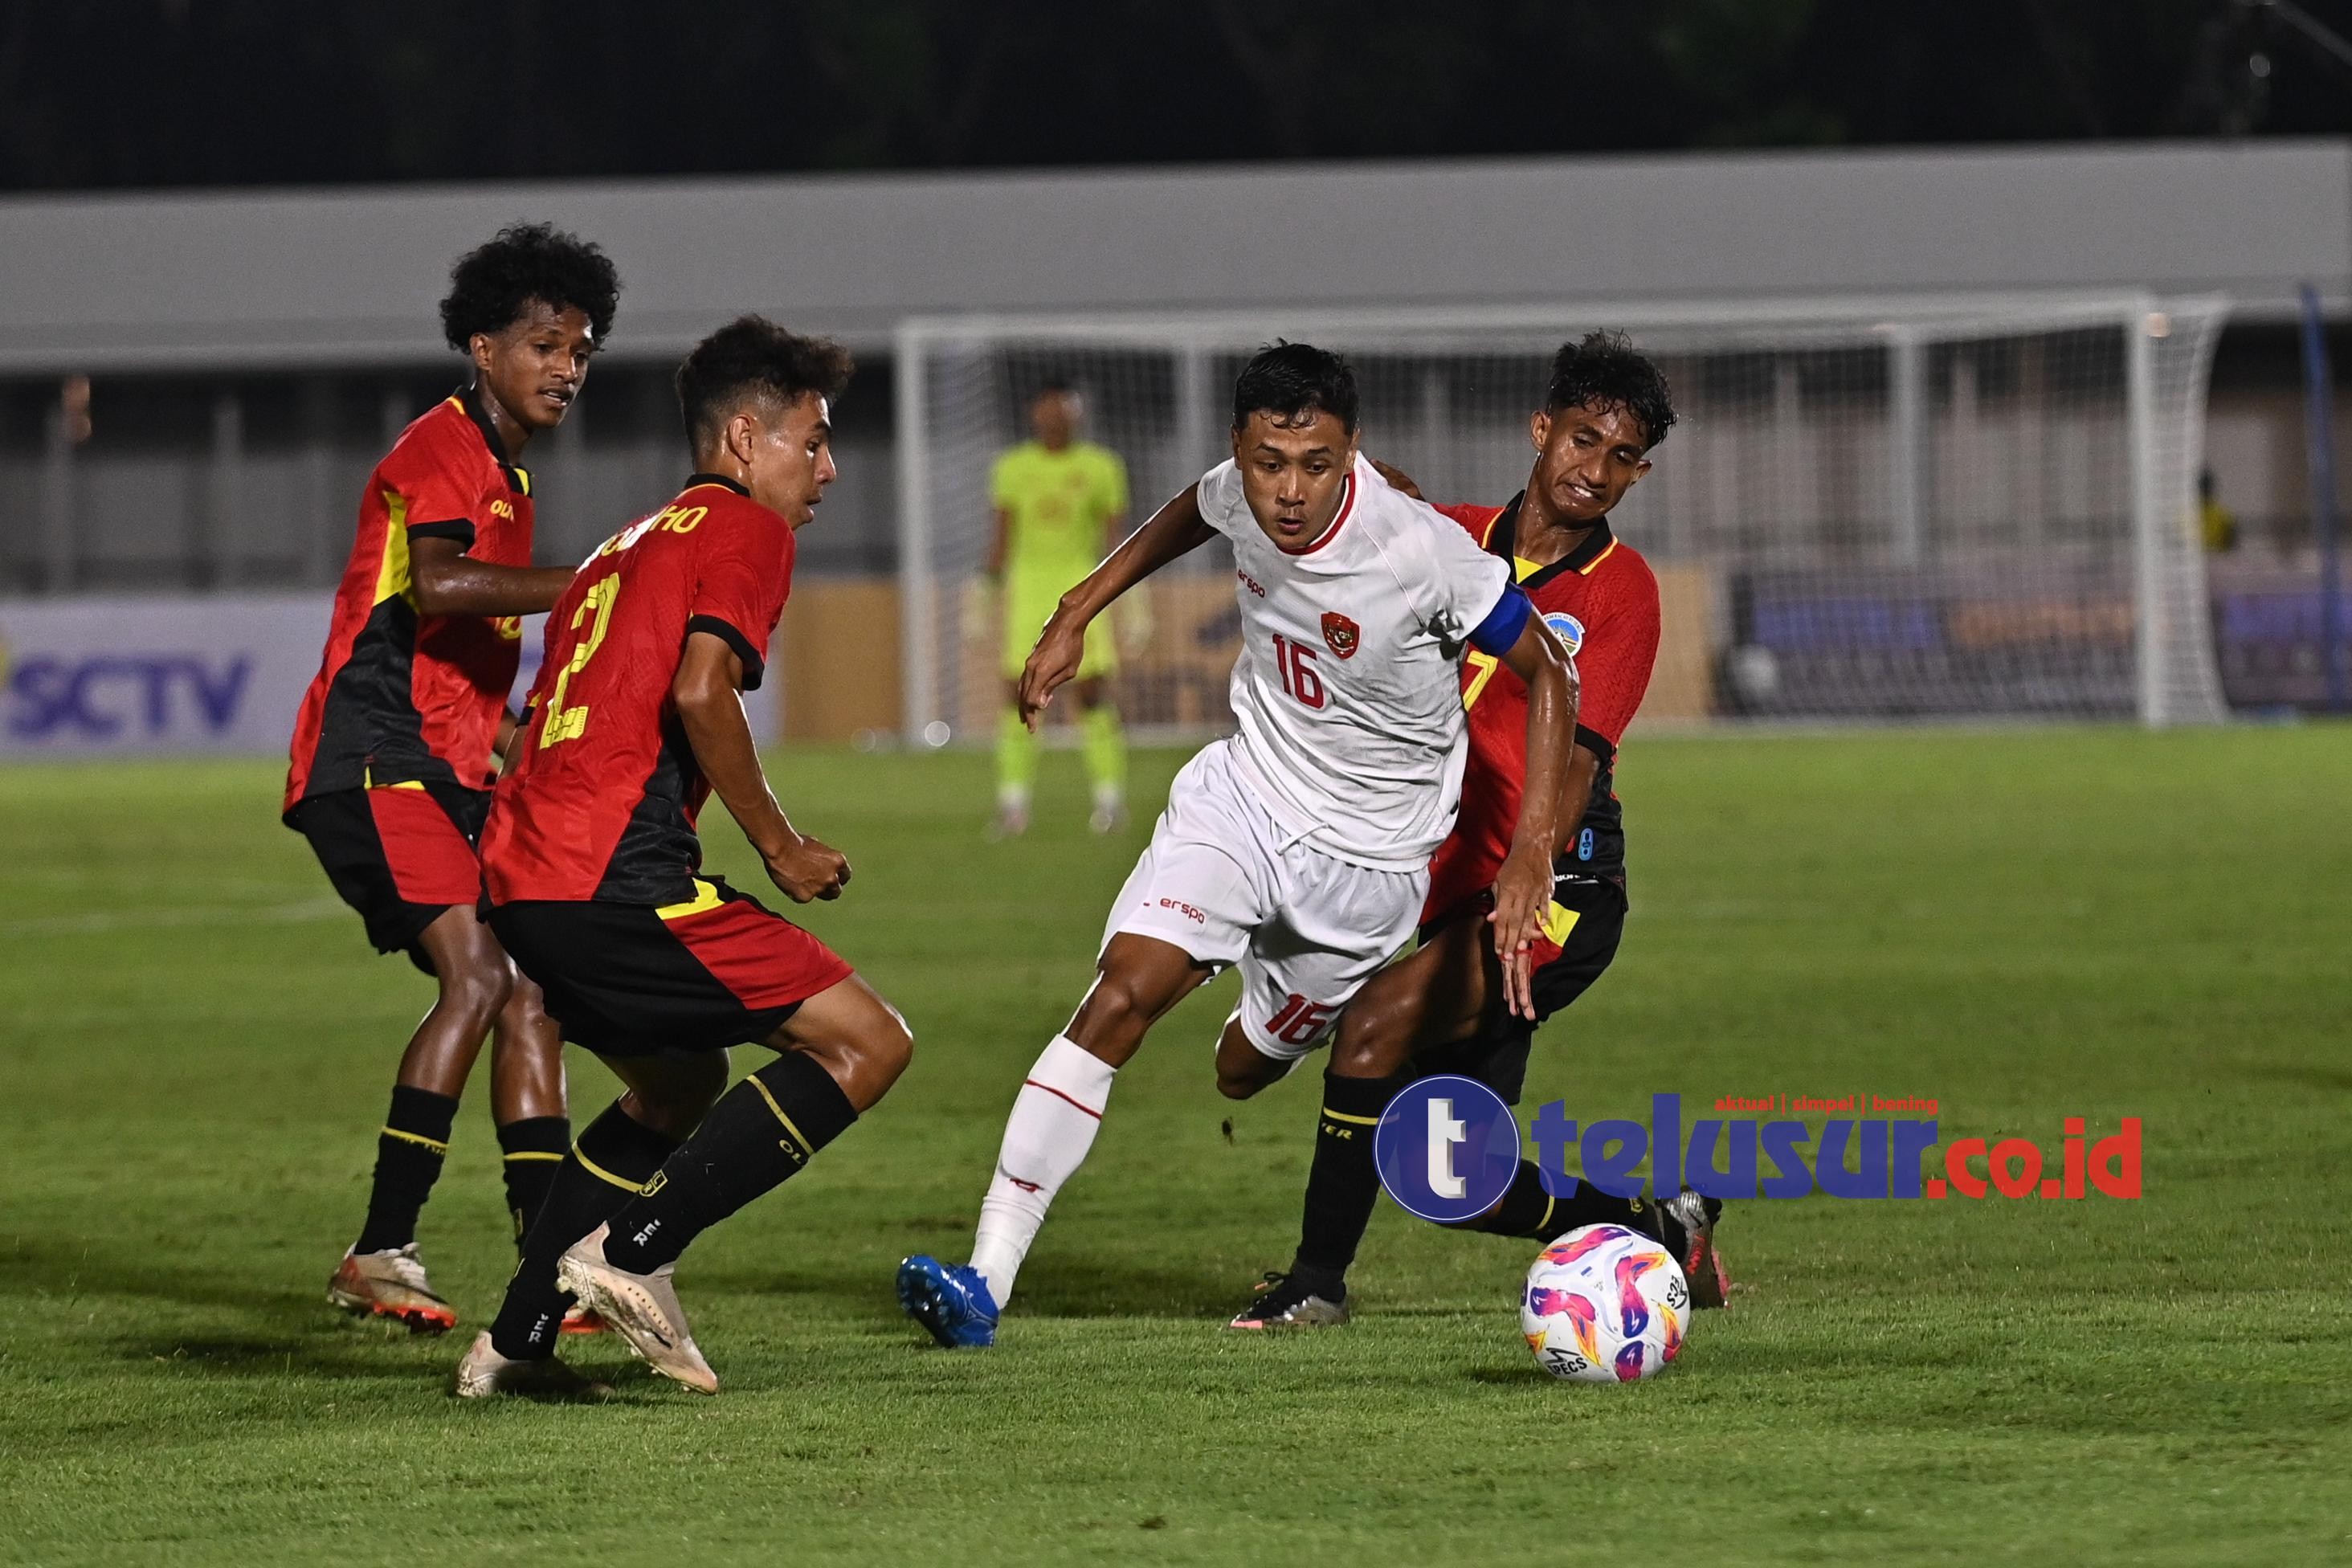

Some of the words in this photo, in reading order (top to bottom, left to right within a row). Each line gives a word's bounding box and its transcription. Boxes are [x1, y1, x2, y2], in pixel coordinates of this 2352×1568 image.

[1238, 569, 1266, 598] erspo
[539, 572, 620, 749] 2
[1272, 633, 1324, 708] 16
[1462, 650, 1499, 713] 7
[8, 652, 251, 741] SCTV
[1160, 897, 1206, 925] erspo
[1264, 993, 1337, 1044] 16
